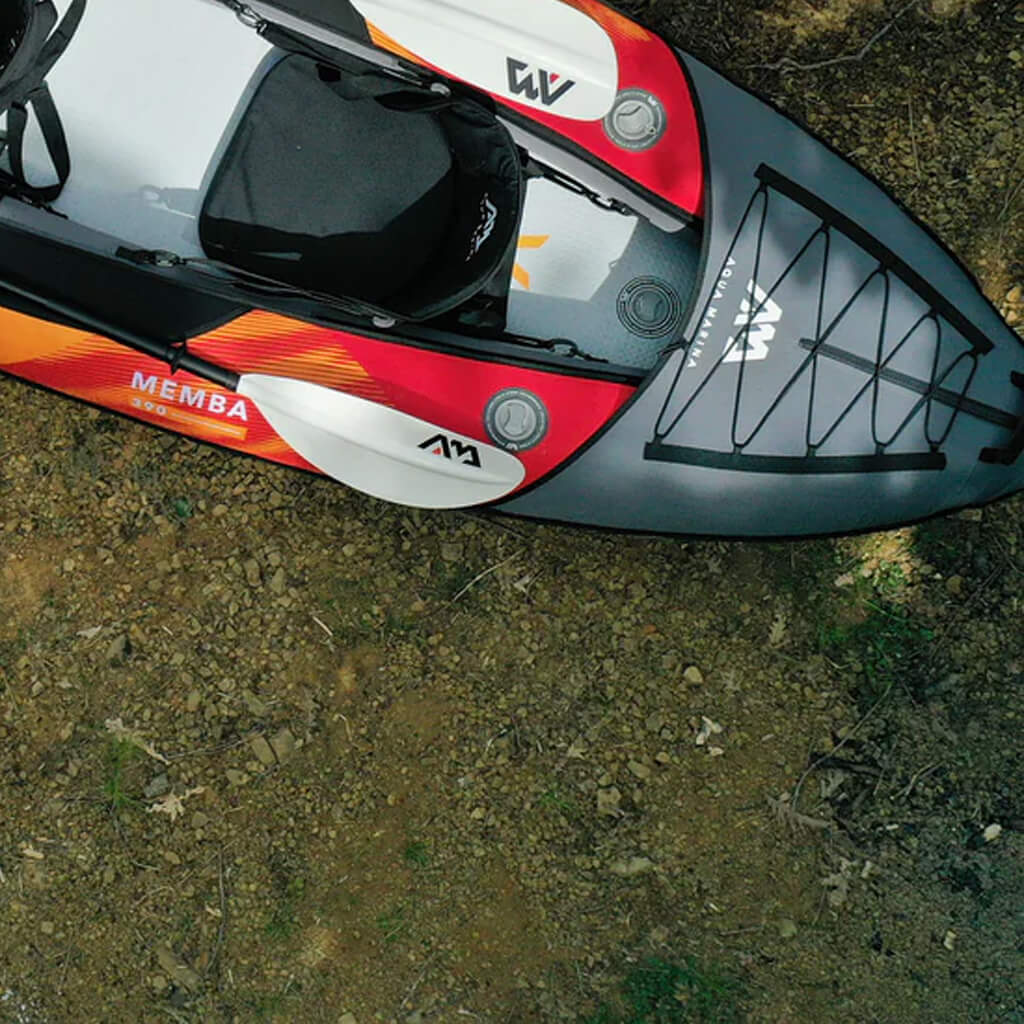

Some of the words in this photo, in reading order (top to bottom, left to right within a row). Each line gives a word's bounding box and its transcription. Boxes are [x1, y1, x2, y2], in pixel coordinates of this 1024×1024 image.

[713, 257, 736, 299] AQUA
[688, 306, 718, 368] MARINA
[131, 371, 248, 422] MEMBA
